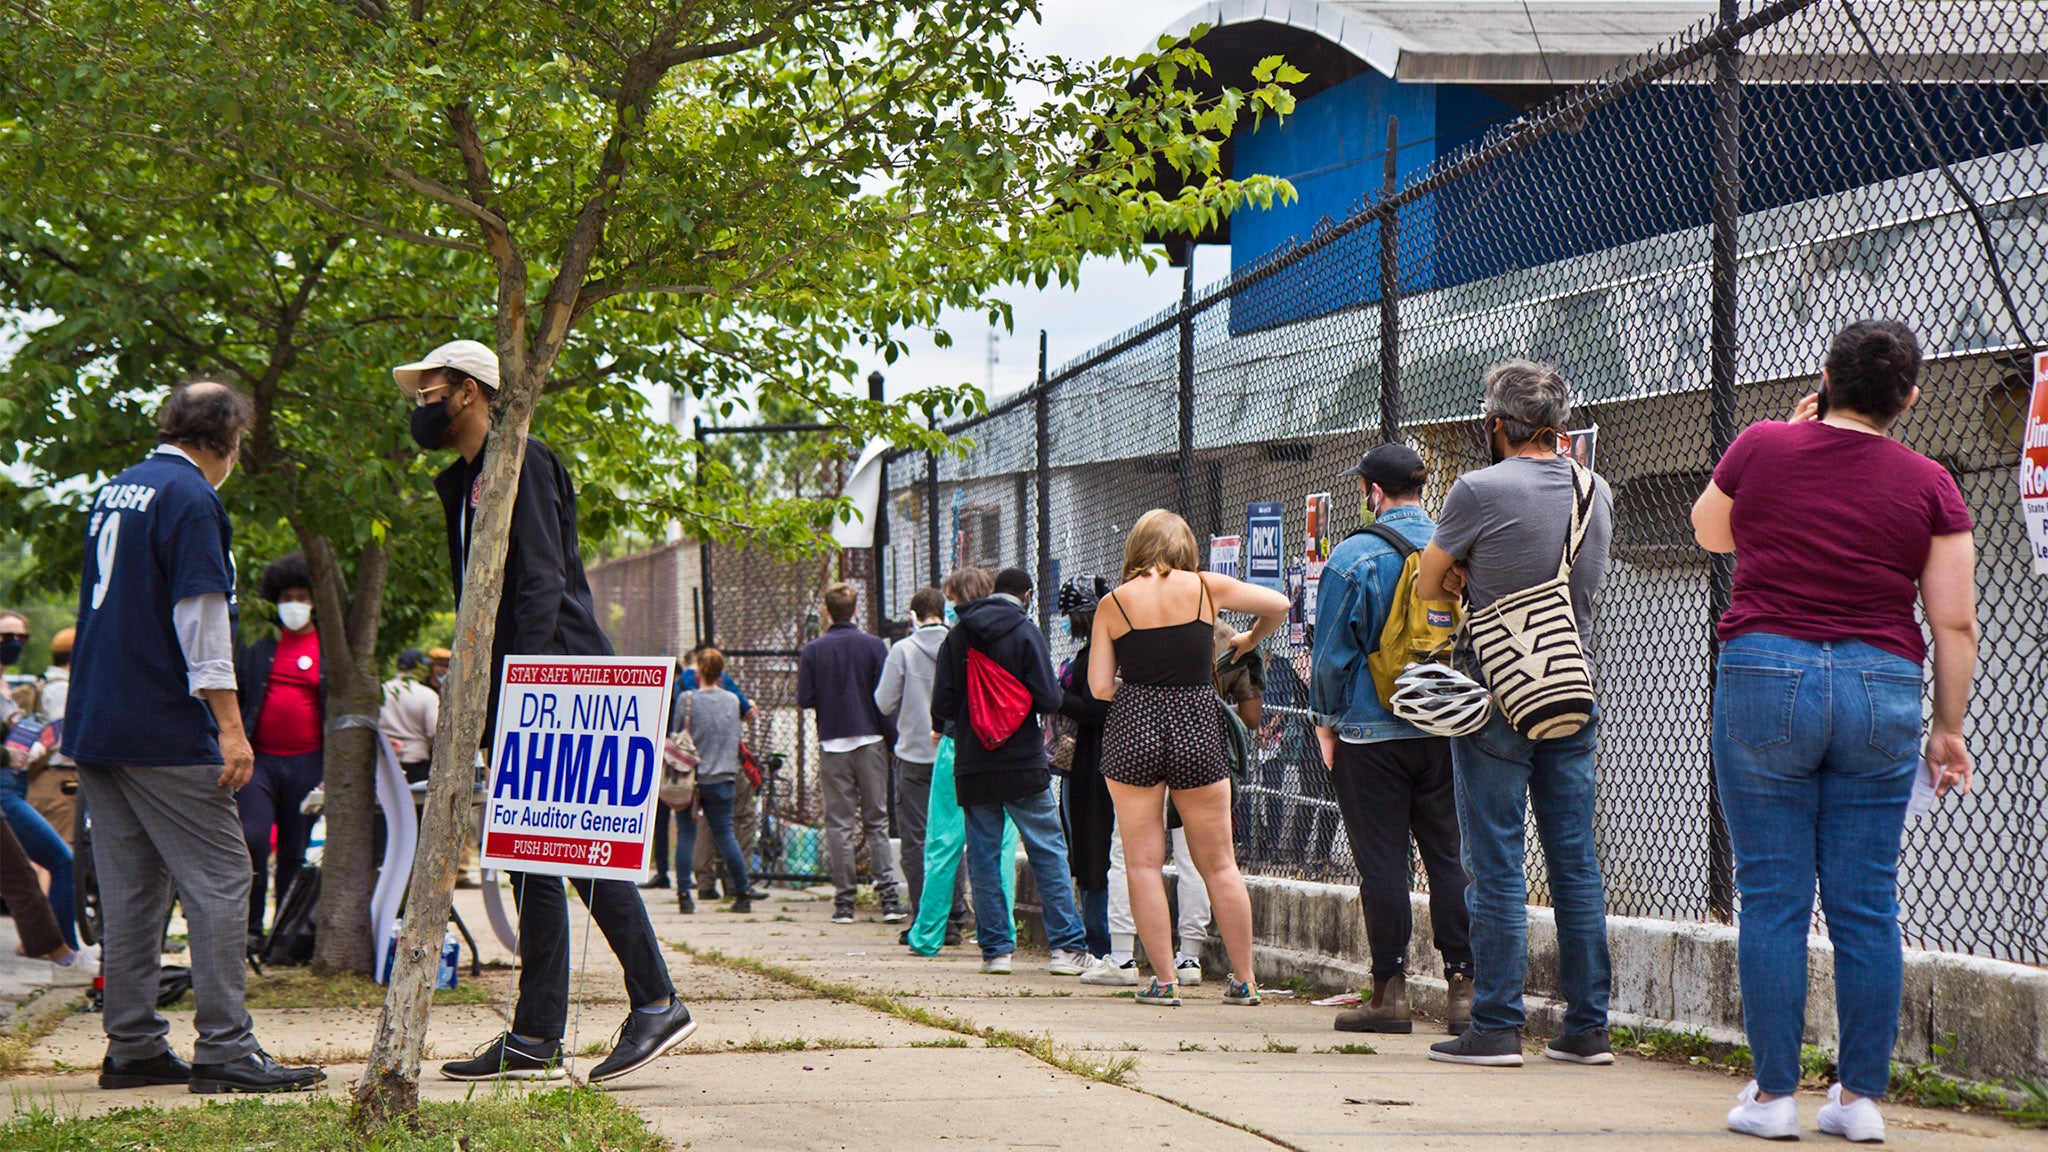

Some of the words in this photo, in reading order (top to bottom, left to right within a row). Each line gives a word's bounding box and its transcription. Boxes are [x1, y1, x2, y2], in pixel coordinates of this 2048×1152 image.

[94, 484, 156, 512] PUSH
[2027, 503, 2045, 514] State
[1252, 526, 1279, 557] RICK!
[510, 667, 540, 683] STAY
[540, 668, 569, 683] SAFE
[572, 668, 611, 684] WHILE
[613, 669, 662, 684] VOTING
[519, 692, 561, 729] DR.
[571, 694, 639, 731] NINA
[493, 731, 655, 807] AHMAD
[493, 804, 518, 825] For
[520, 806, 577, 830] Auditor
[581, 810, 644, 834] General
[513, 839, 540, 856] PUSH
[542, 842, 587, 859] BUTTON
[587, 841, 612, 865] #9
